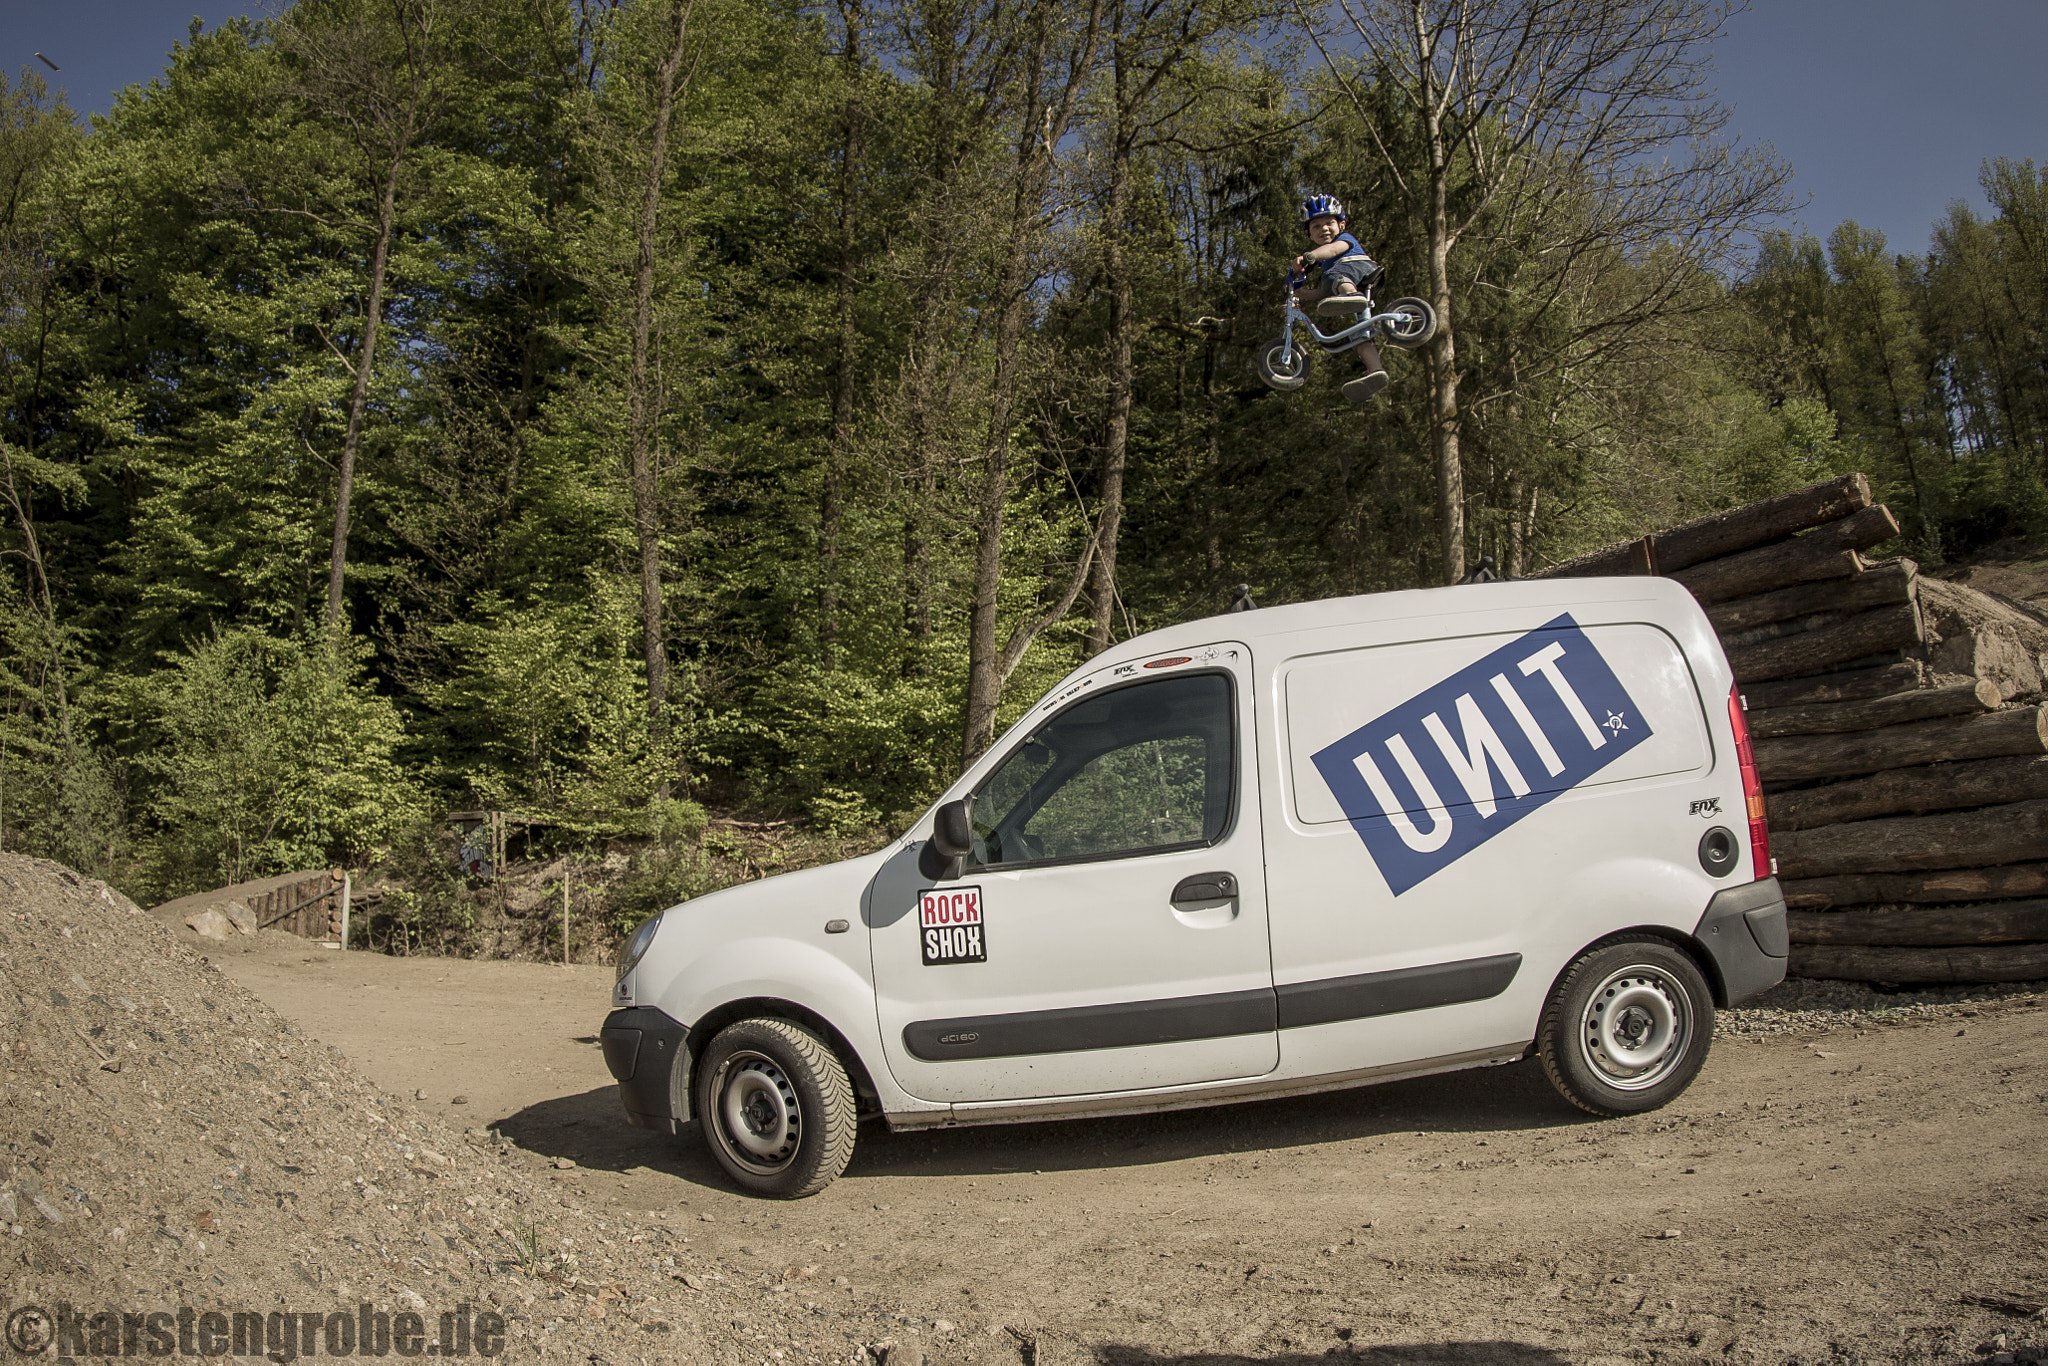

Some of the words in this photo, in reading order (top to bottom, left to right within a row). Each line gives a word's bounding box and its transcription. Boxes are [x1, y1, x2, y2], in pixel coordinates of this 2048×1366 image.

[1689, 797, 1722, 815] FOX
[923, 893, 978, 925] ROCK
[925, 926, 982, 959] SHOX
